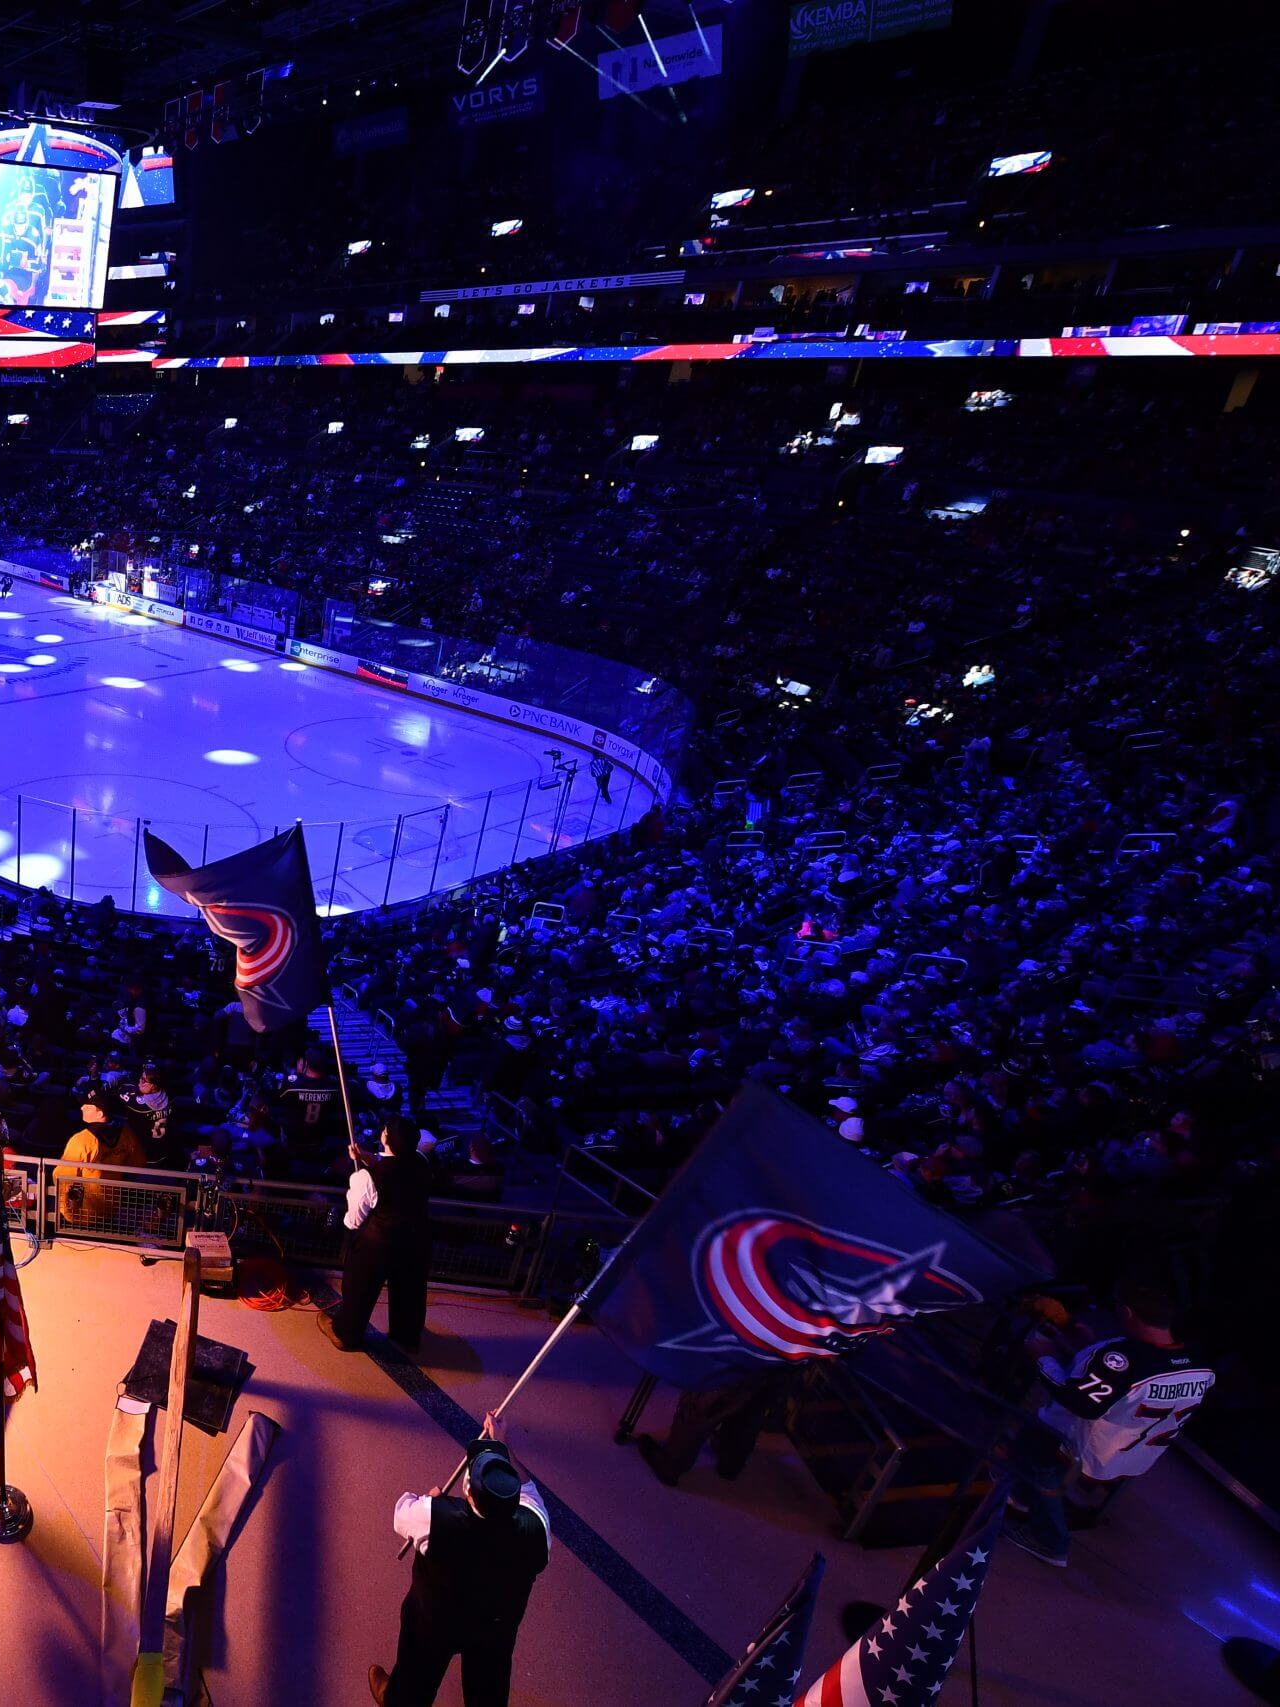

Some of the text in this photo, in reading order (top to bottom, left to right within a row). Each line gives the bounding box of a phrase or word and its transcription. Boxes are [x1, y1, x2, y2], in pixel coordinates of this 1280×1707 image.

[803, 0, 867, 28] KEMBA
[643, 47, 704, 69] Naionwide
[452, 78, 539, 112] VORYS
[463, 277, 625, 298] LET'S GO JACKETS
[293, 642, 340, 664] enterprise
[422, 679, 480, 706] Kroger Kroger
[608, 739, 635, 760] TOYOTA
[304, 1103, 321, 1125] 8
[1078, 1373, 1114, 1404] 72
